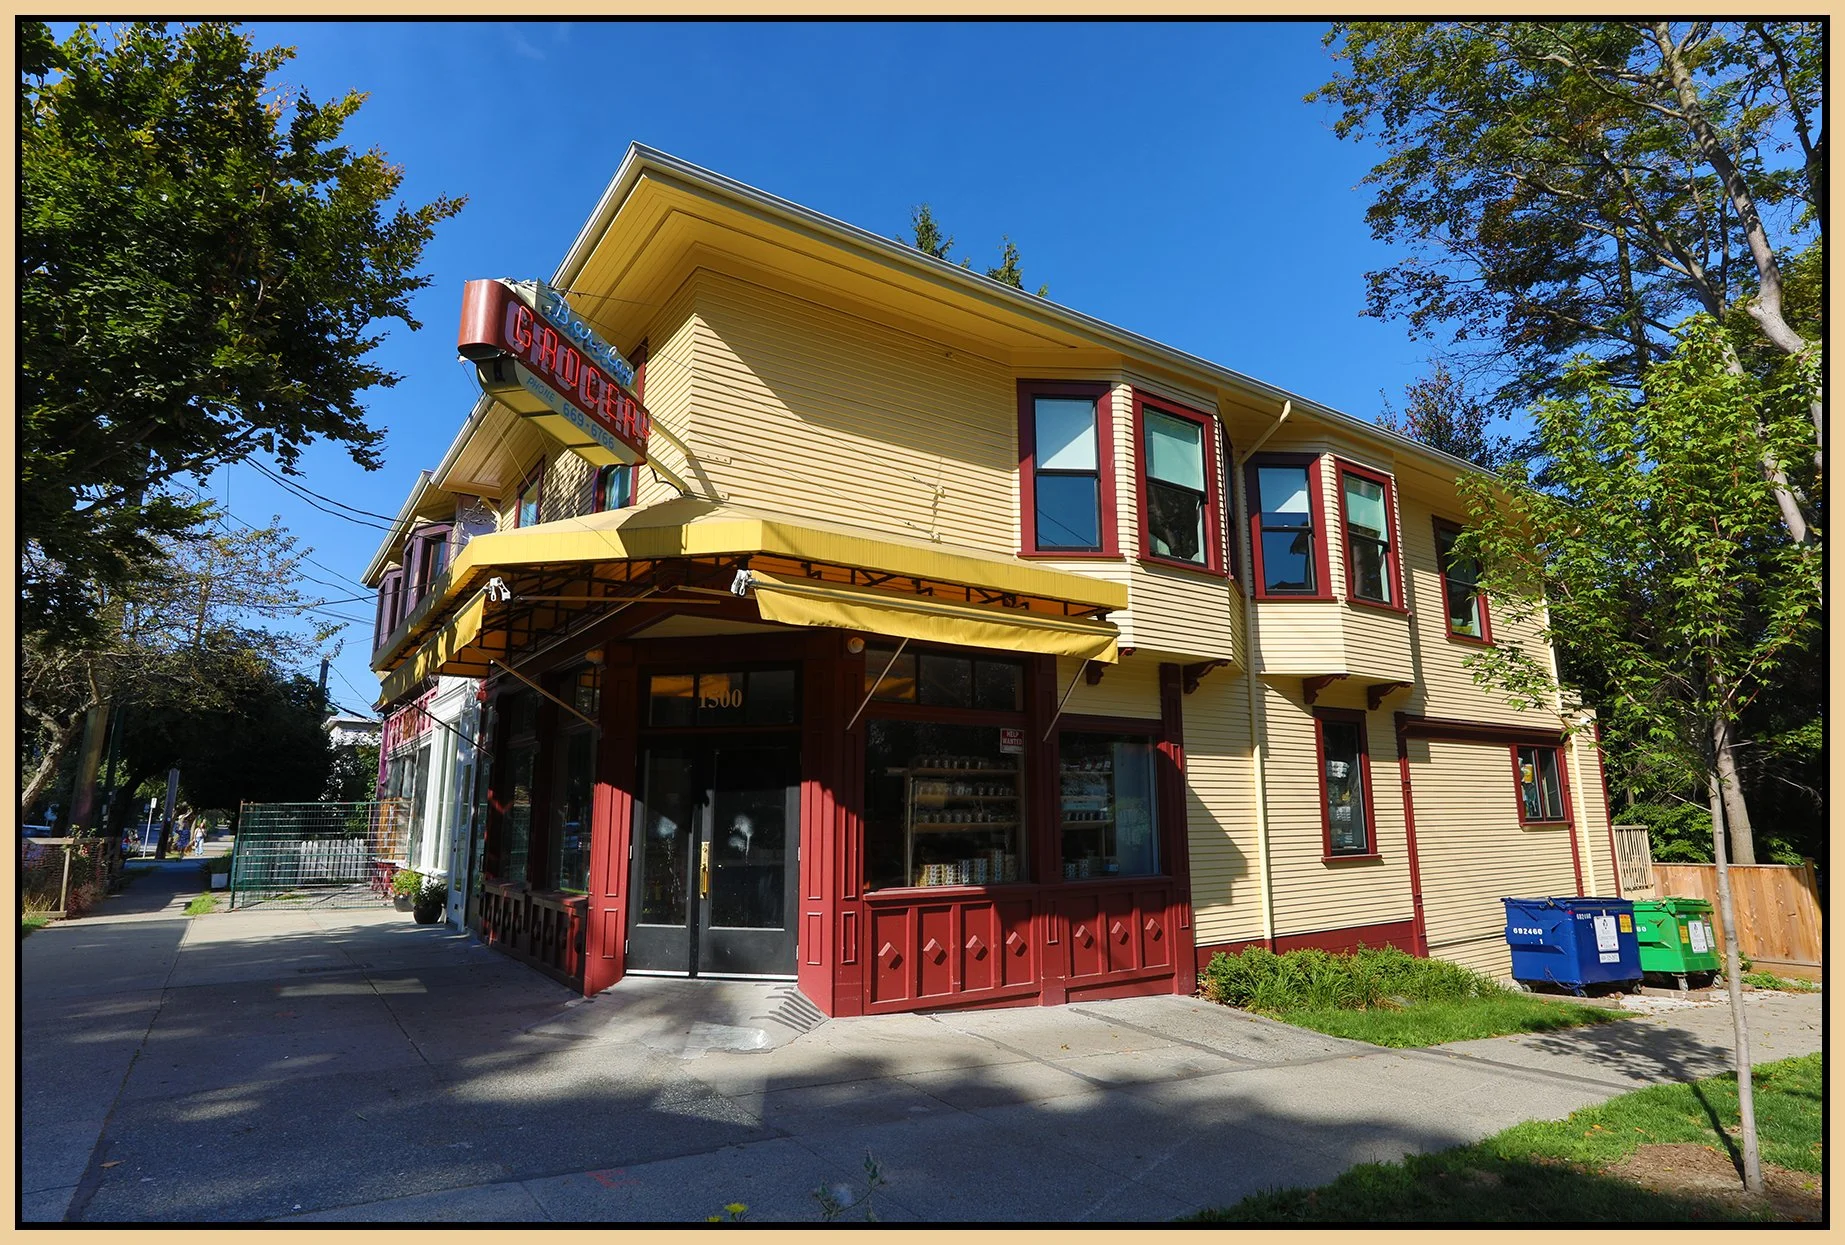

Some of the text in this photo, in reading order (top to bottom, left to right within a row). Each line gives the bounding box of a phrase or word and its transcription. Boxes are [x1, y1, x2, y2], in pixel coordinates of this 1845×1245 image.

[505, 300, 653, 447] GROCERY
[526, 376, 556, 403] PHONE
[698, 688, 743, 709] 1500
